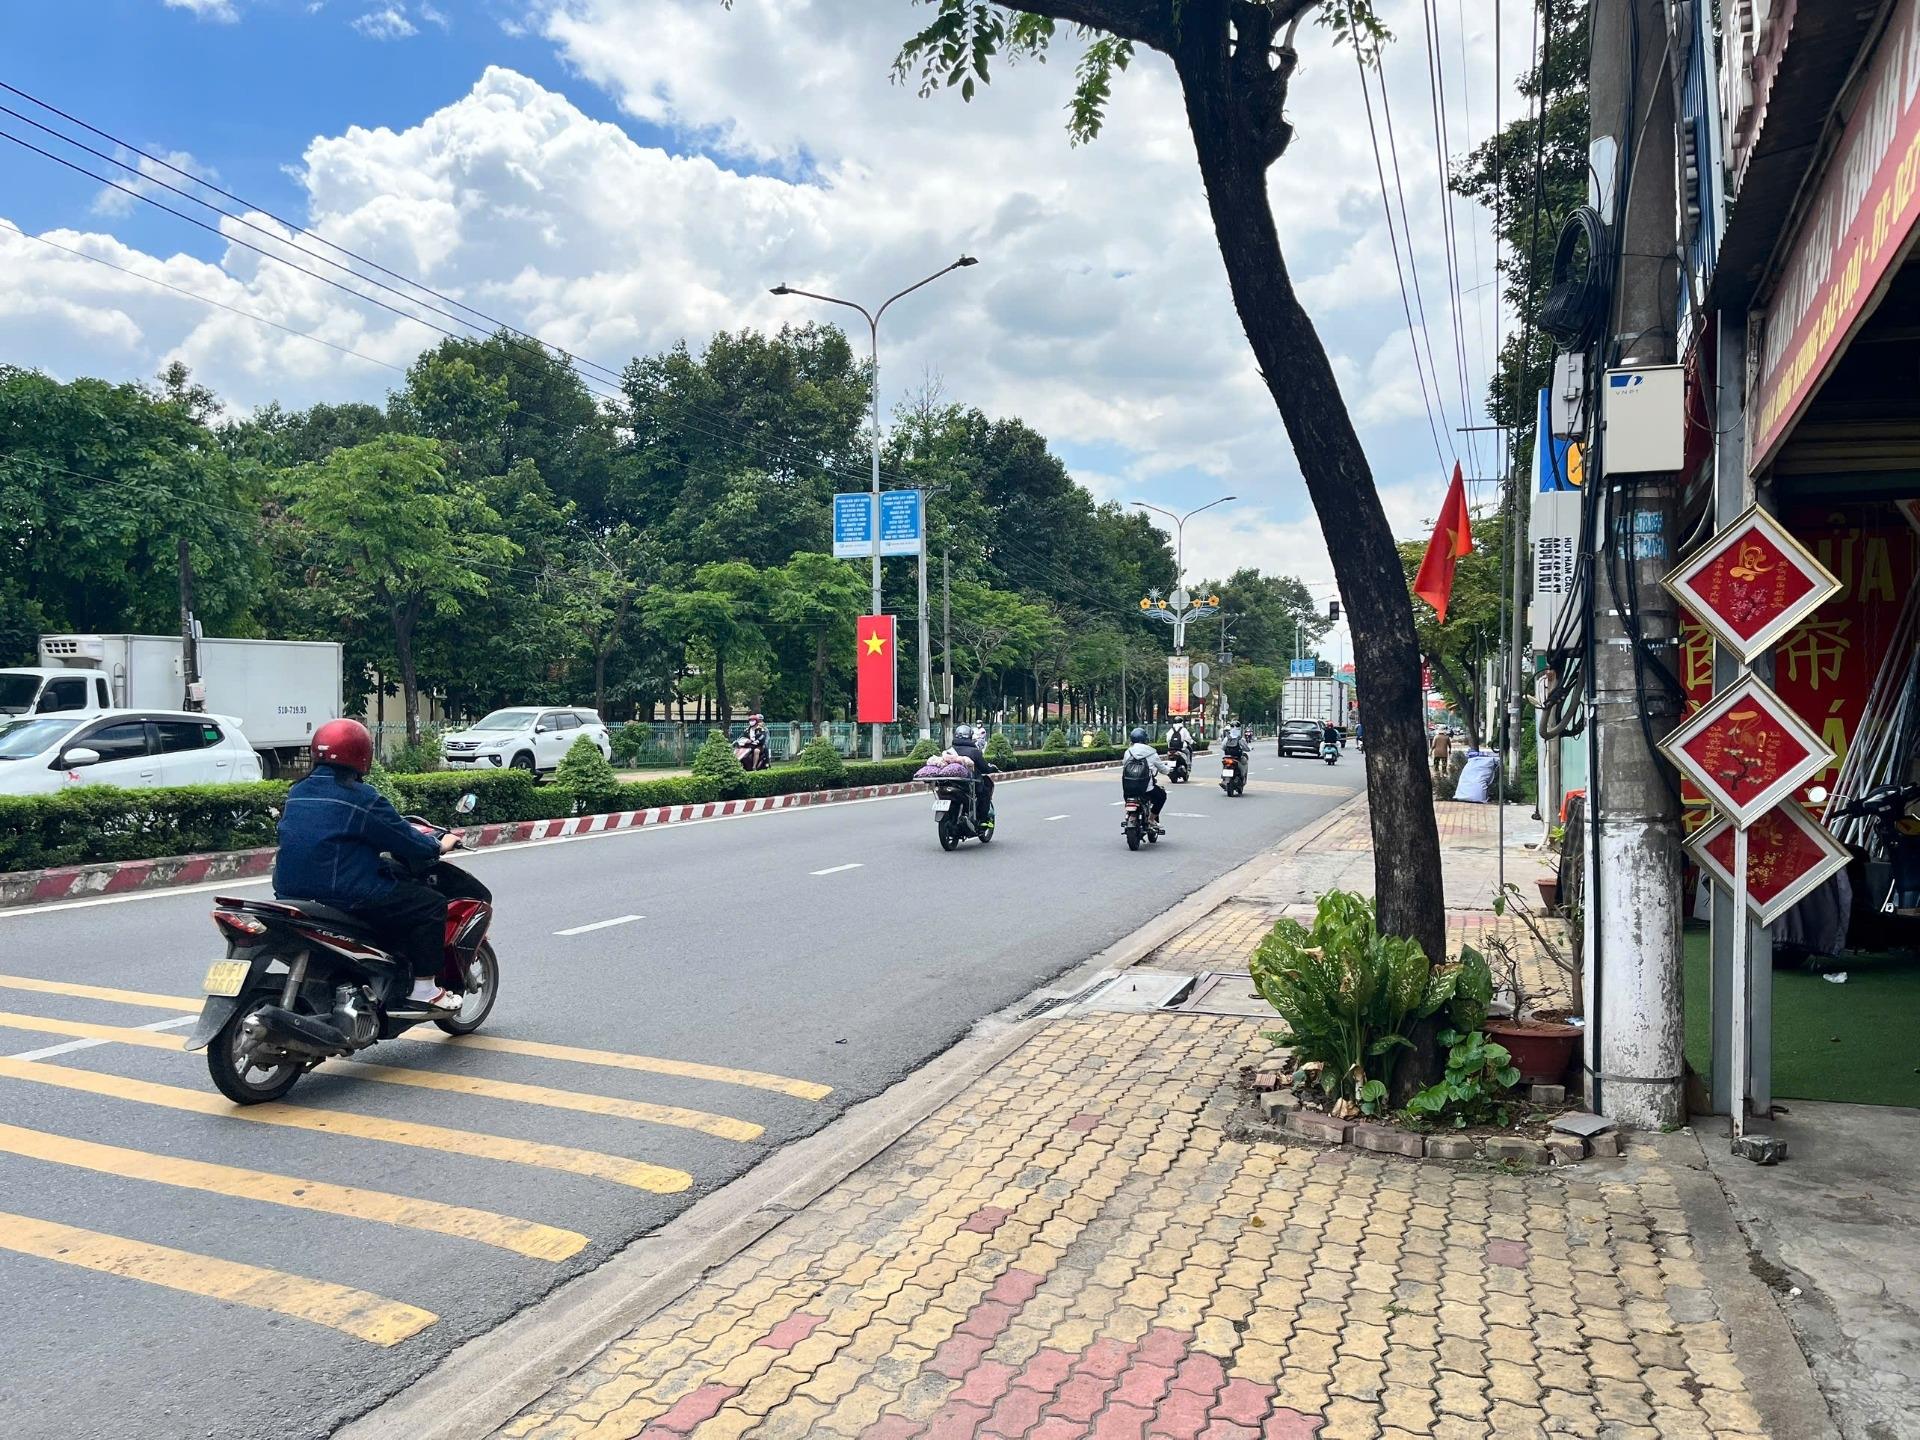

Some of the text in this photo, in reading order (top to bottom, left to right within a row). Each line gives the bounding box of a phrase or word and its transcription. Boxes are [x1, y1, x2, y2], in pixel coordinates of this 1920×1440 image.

[1763, 264, 1800, 387] TRANH
[1838, 30, 1905, 248] TRANH
[1819, 283, 1839, 352] CÁC
[1838, 235, 1864, 315] LOẠI
